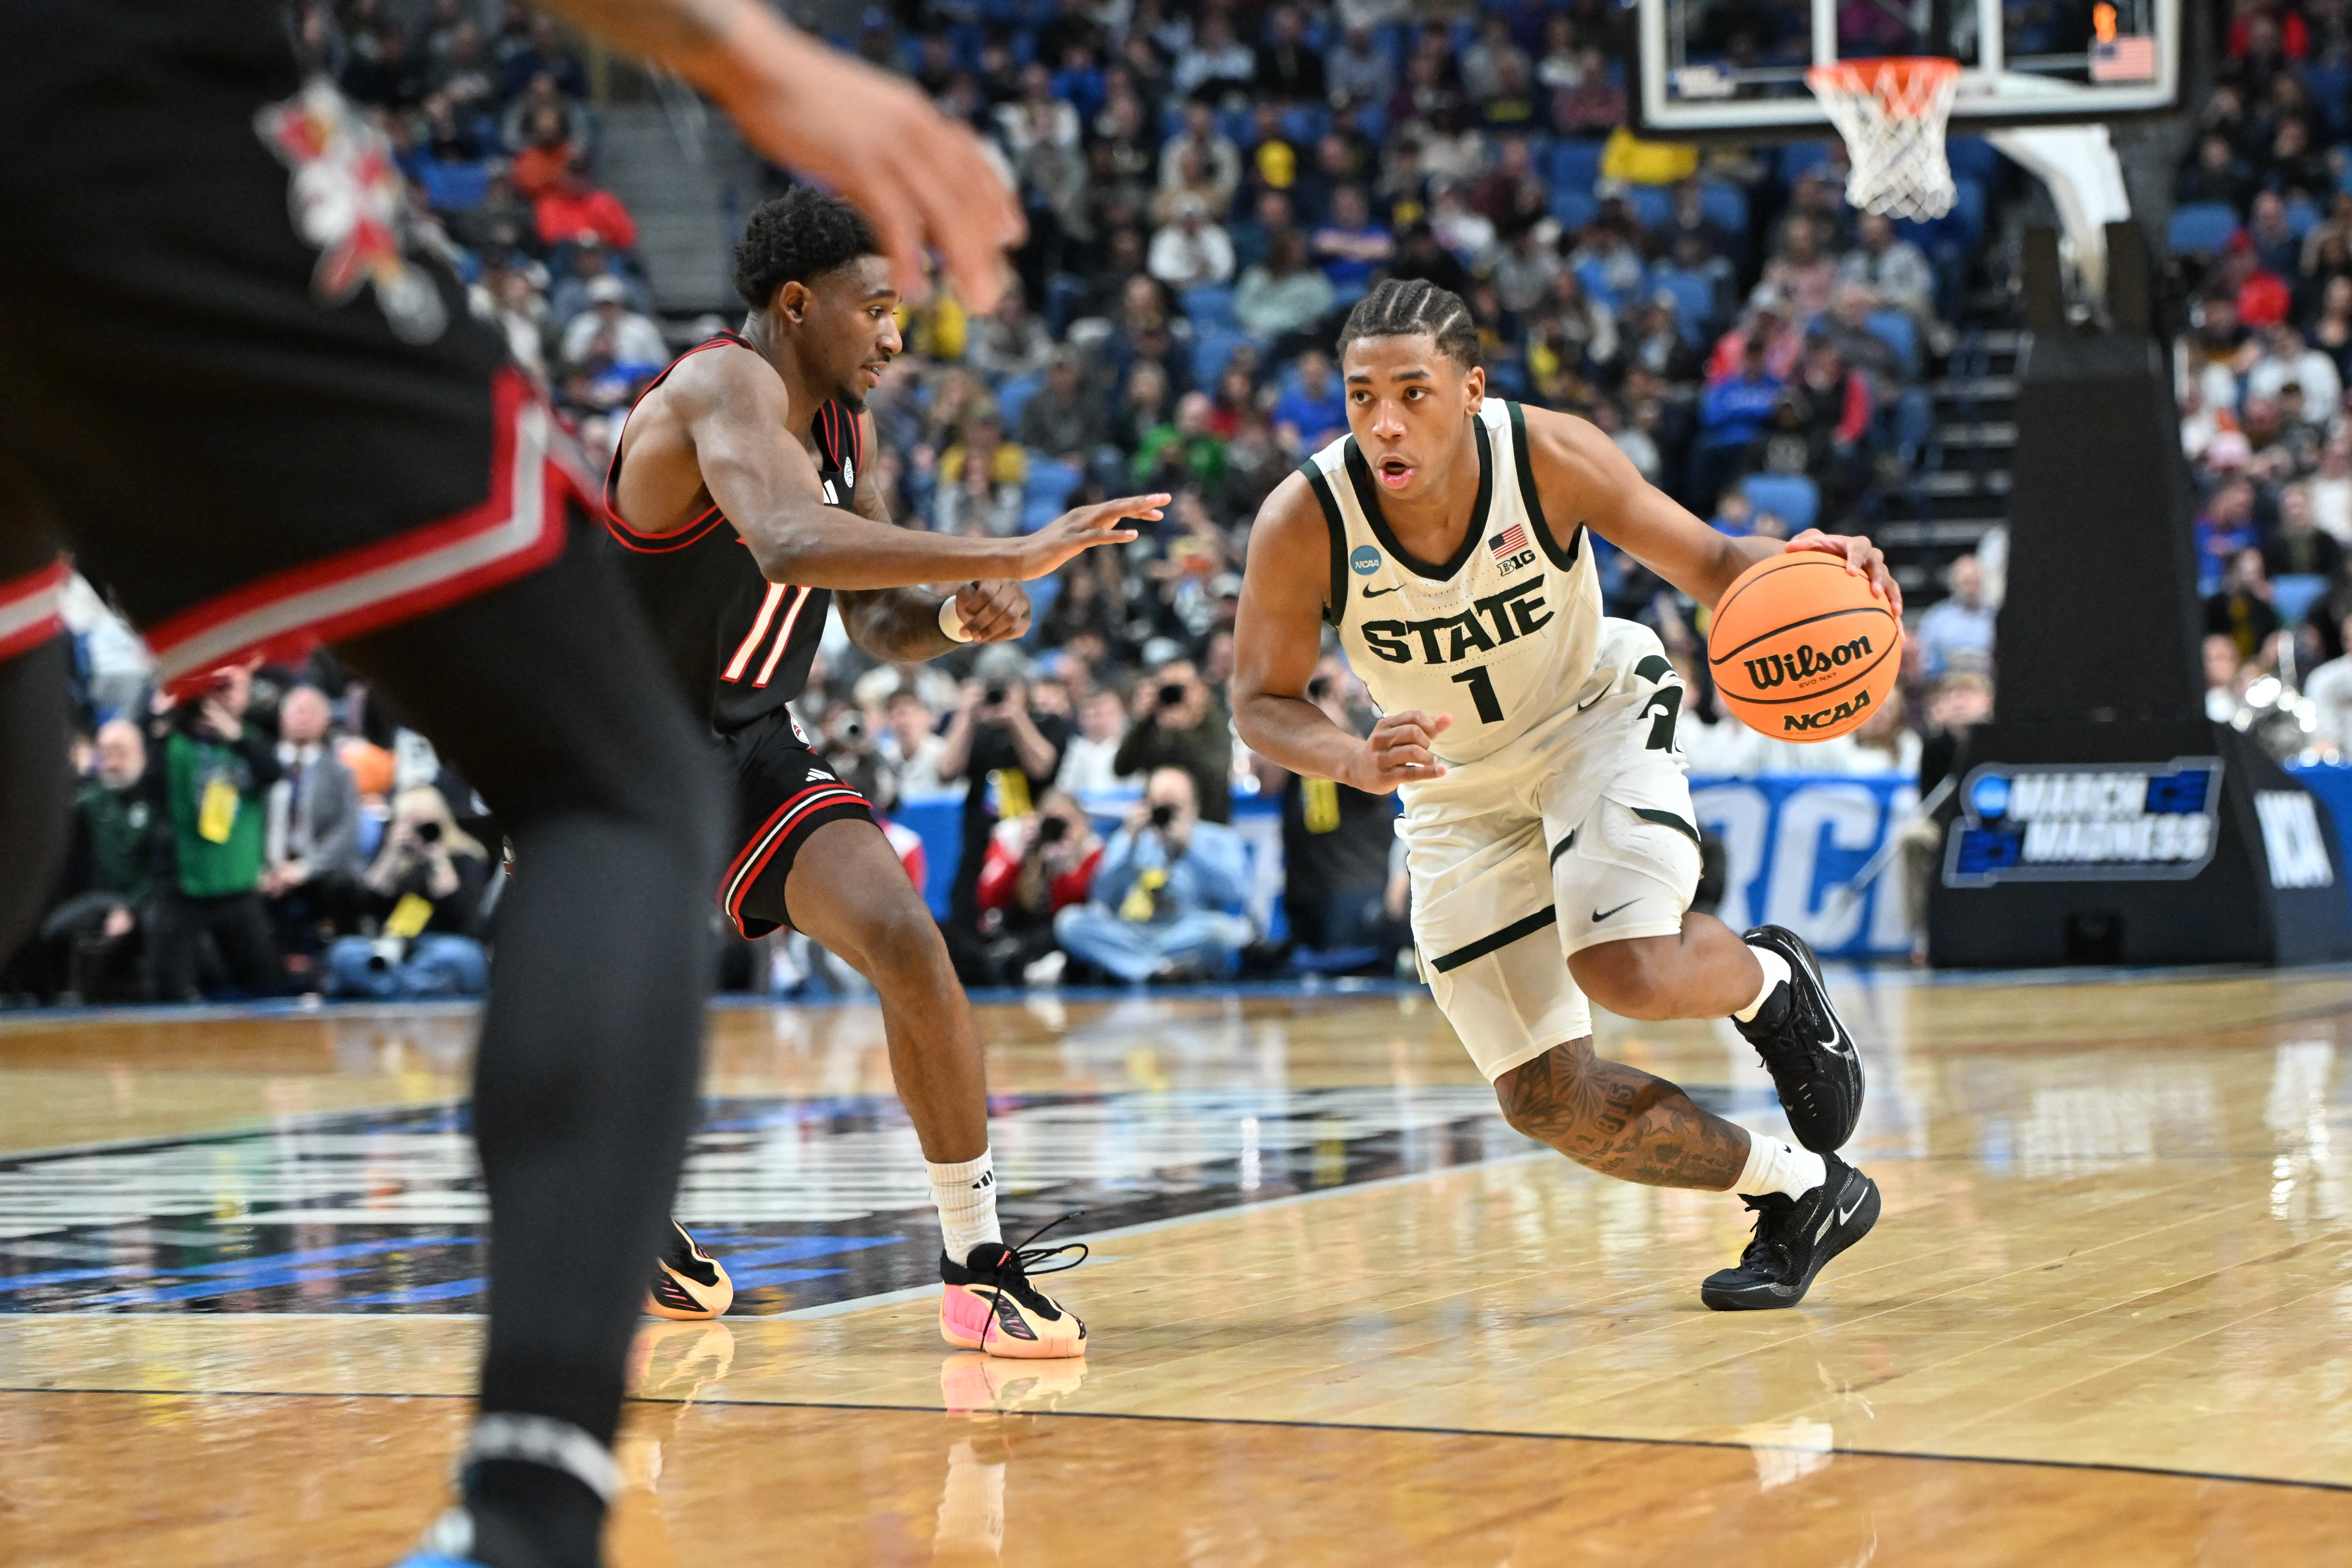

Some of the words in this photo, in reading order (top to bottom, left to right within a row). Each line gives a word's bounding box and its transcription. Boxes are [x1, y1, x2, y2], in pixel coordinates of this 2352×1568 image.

[1354, 559, 1380, 569] NCAA
[720, 581, 813, 688] 11
[1361, 574, 1555, 665] STATE
[1743, 635, 1874, 690] Wilson
[1798, 679, 1817, 689] EVO
[1819, 671, 1838, 682] NXT
[1451, 665, 1505, 724] 1
[1784, 689, 1871, 731] NCAA
